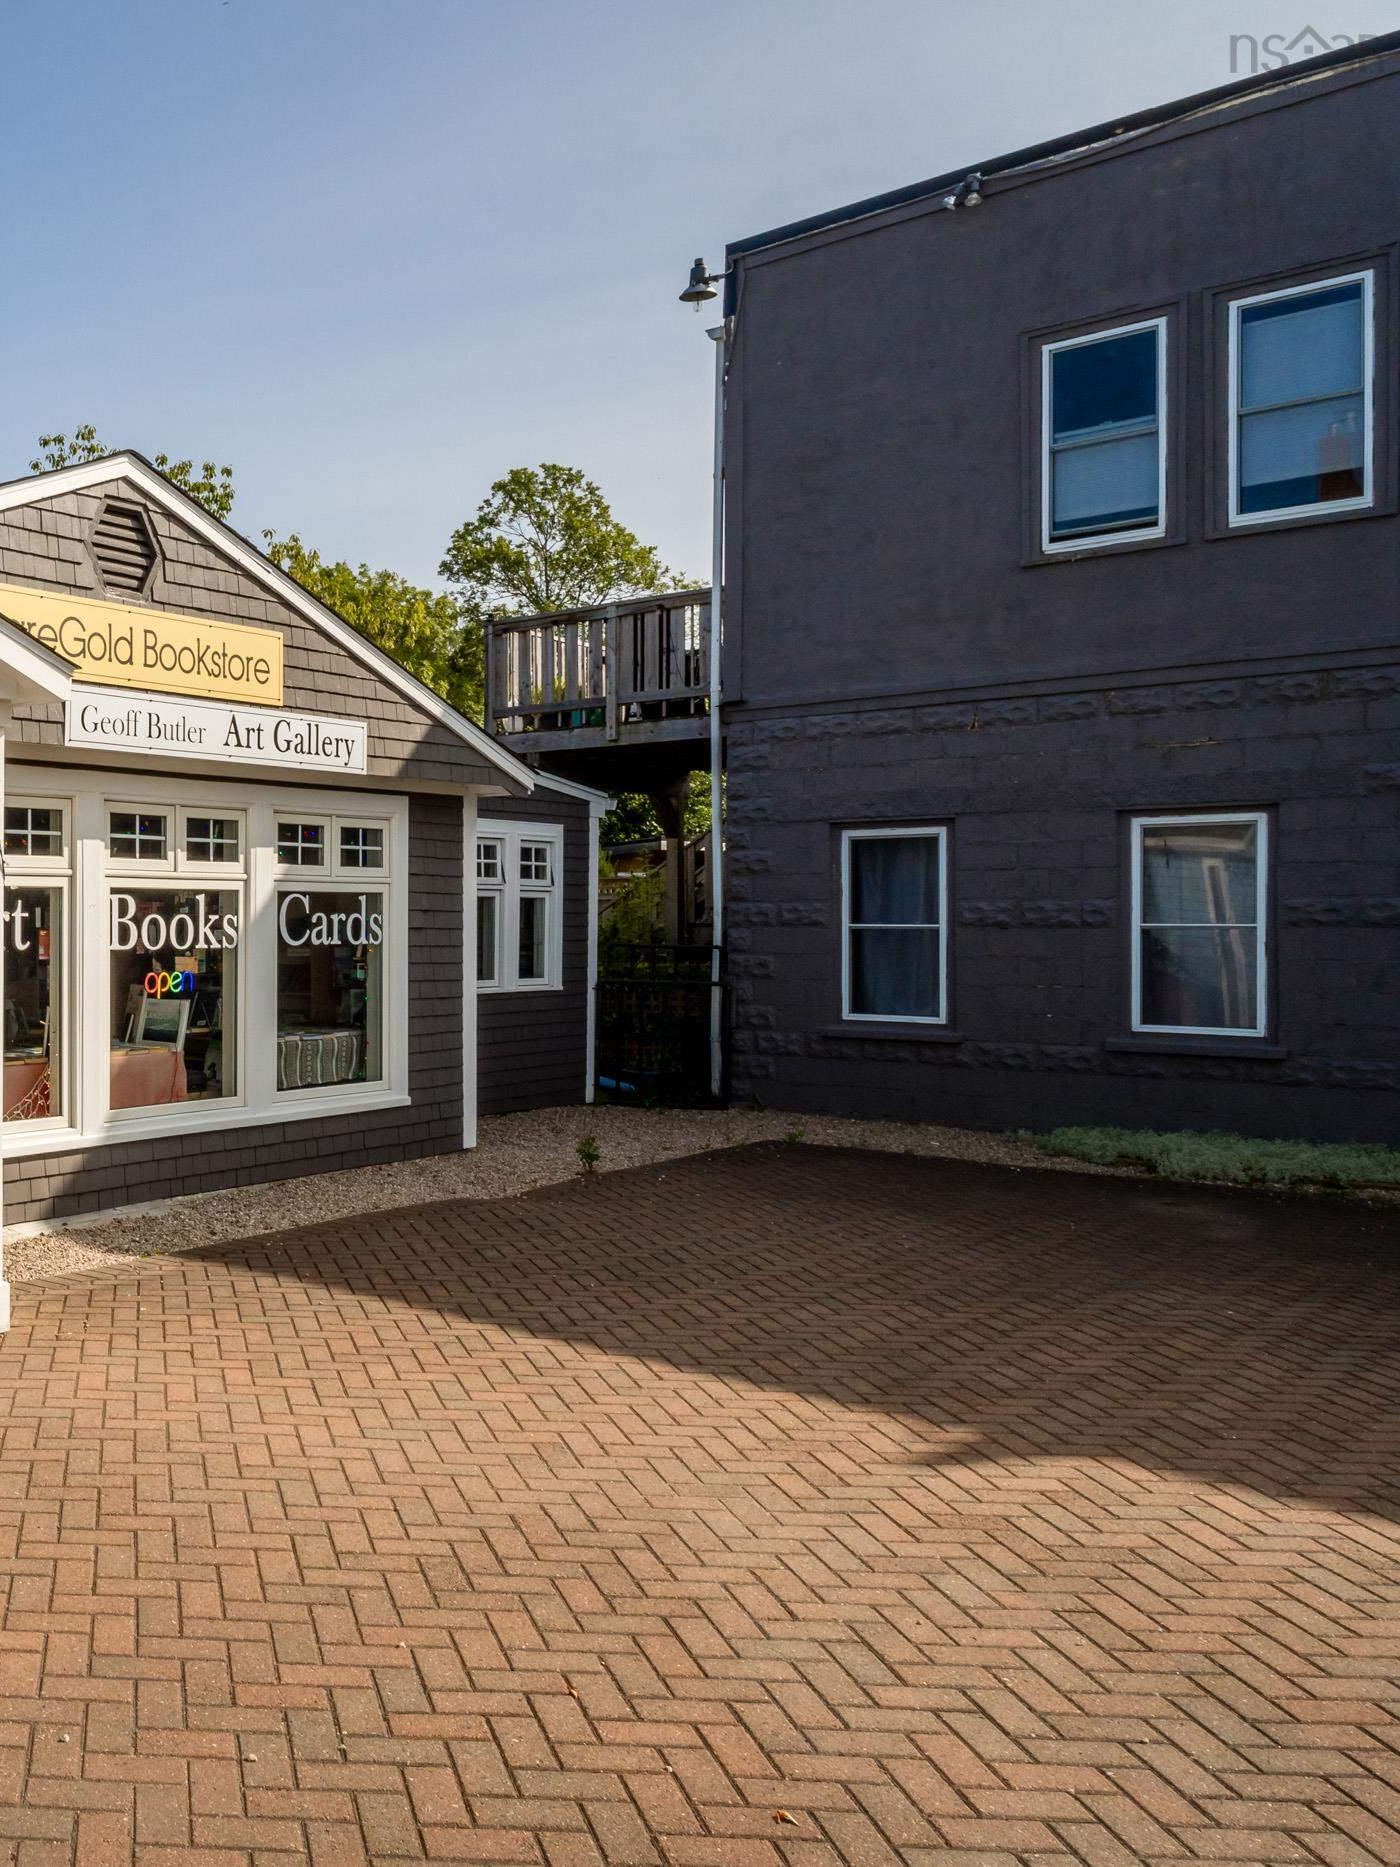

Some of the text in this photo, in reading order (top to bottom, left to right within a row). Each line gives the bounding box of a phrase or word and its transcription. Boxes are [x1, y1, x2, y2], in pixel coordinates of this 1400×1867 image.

[144, 629, 271, 685] Bookstore
[81, 704, 356, 766] Geoff Butler Art Gallery
[109, 893, 238, 951] Books
[279, 893, 383, 947] Cards
[145, 970, 196, 1000] open
